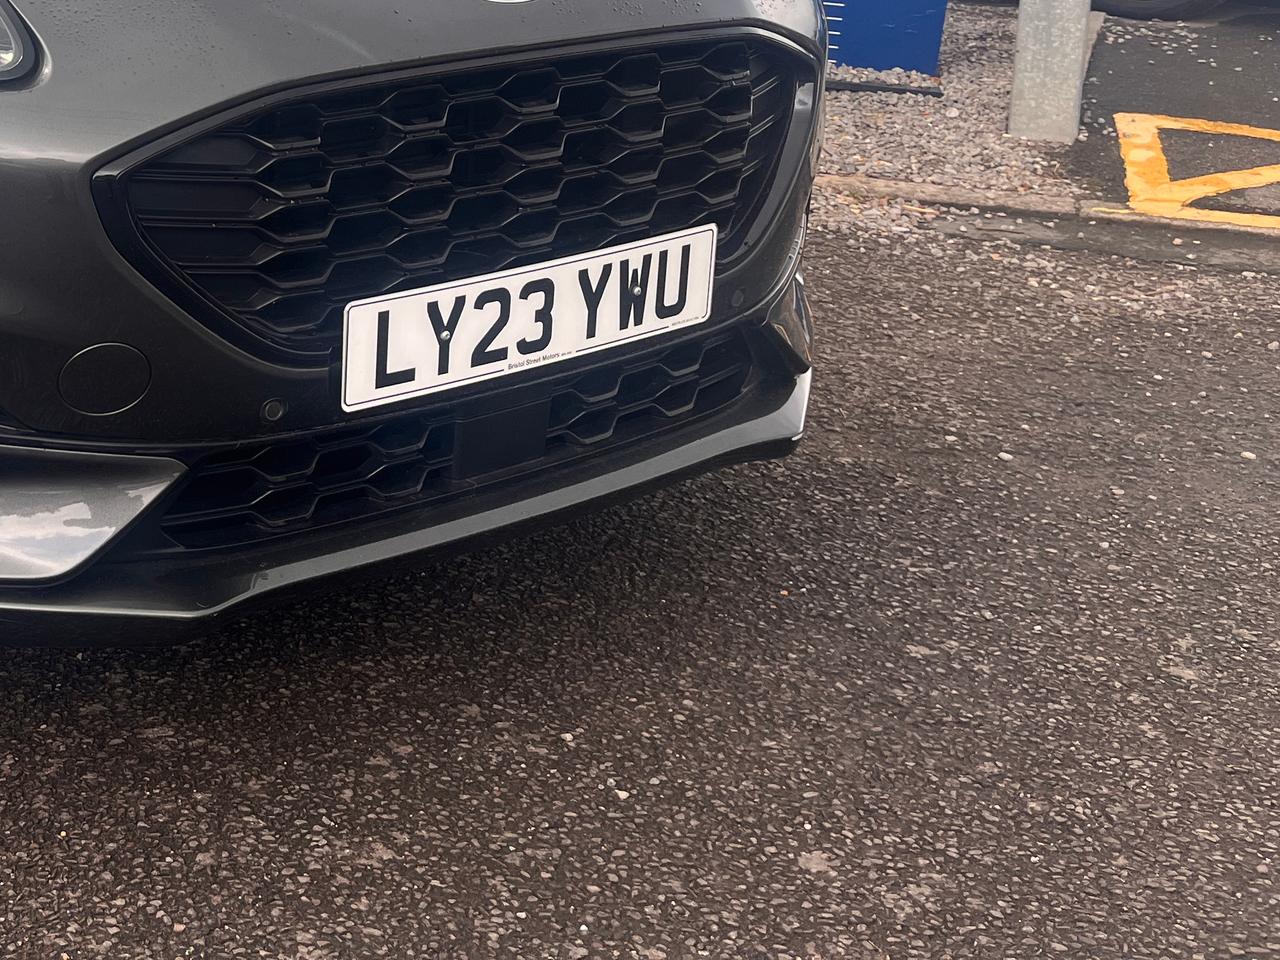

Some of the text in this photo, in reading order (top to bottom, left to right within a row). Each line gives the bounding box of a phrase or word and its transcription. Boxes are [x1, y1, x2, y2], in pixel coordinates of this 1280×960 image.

[375, 244, 691, 389] LY23 YWU
[508, 362, 525, 370] Bristol
[526, 357, 541, 366] Street
[542, 353, 560, 361] Motors
